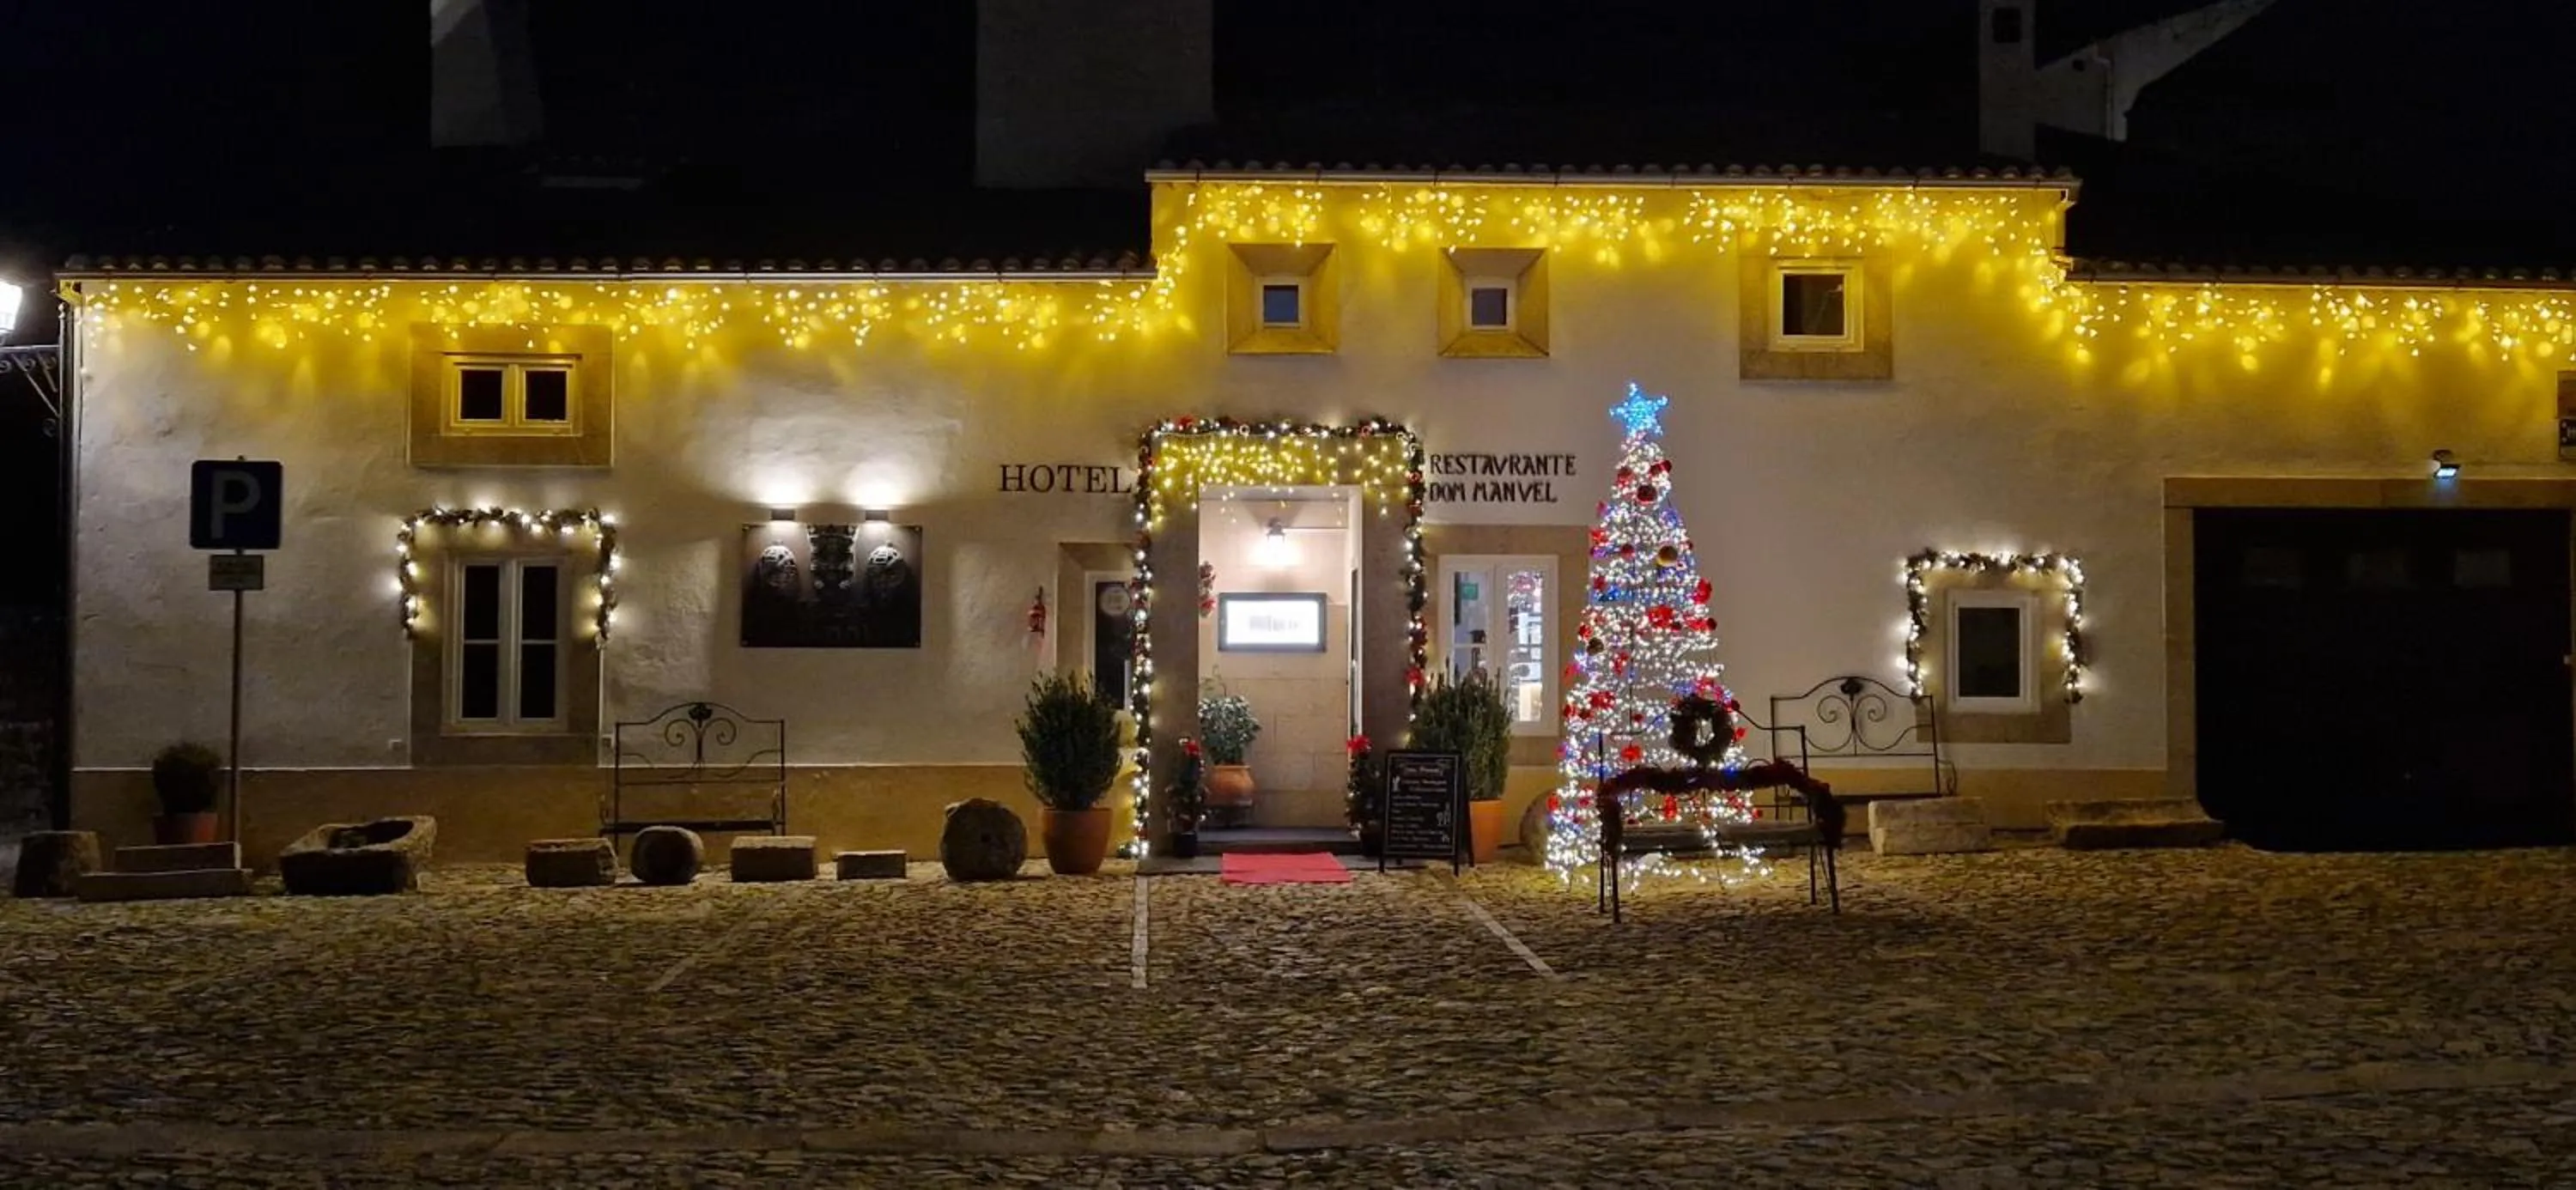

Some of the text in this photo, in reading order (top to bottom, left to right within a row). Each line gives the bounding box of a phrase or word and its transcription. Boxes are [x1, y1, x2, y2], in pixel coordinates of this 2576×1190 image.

[1430, 453, 1577, 476] RESTAVRANTE
[999, 464, 1133, 494] HOTEL
[1430, 481, 1558, 503] DOM MANVEL
[210, 471, 261, 539] P
